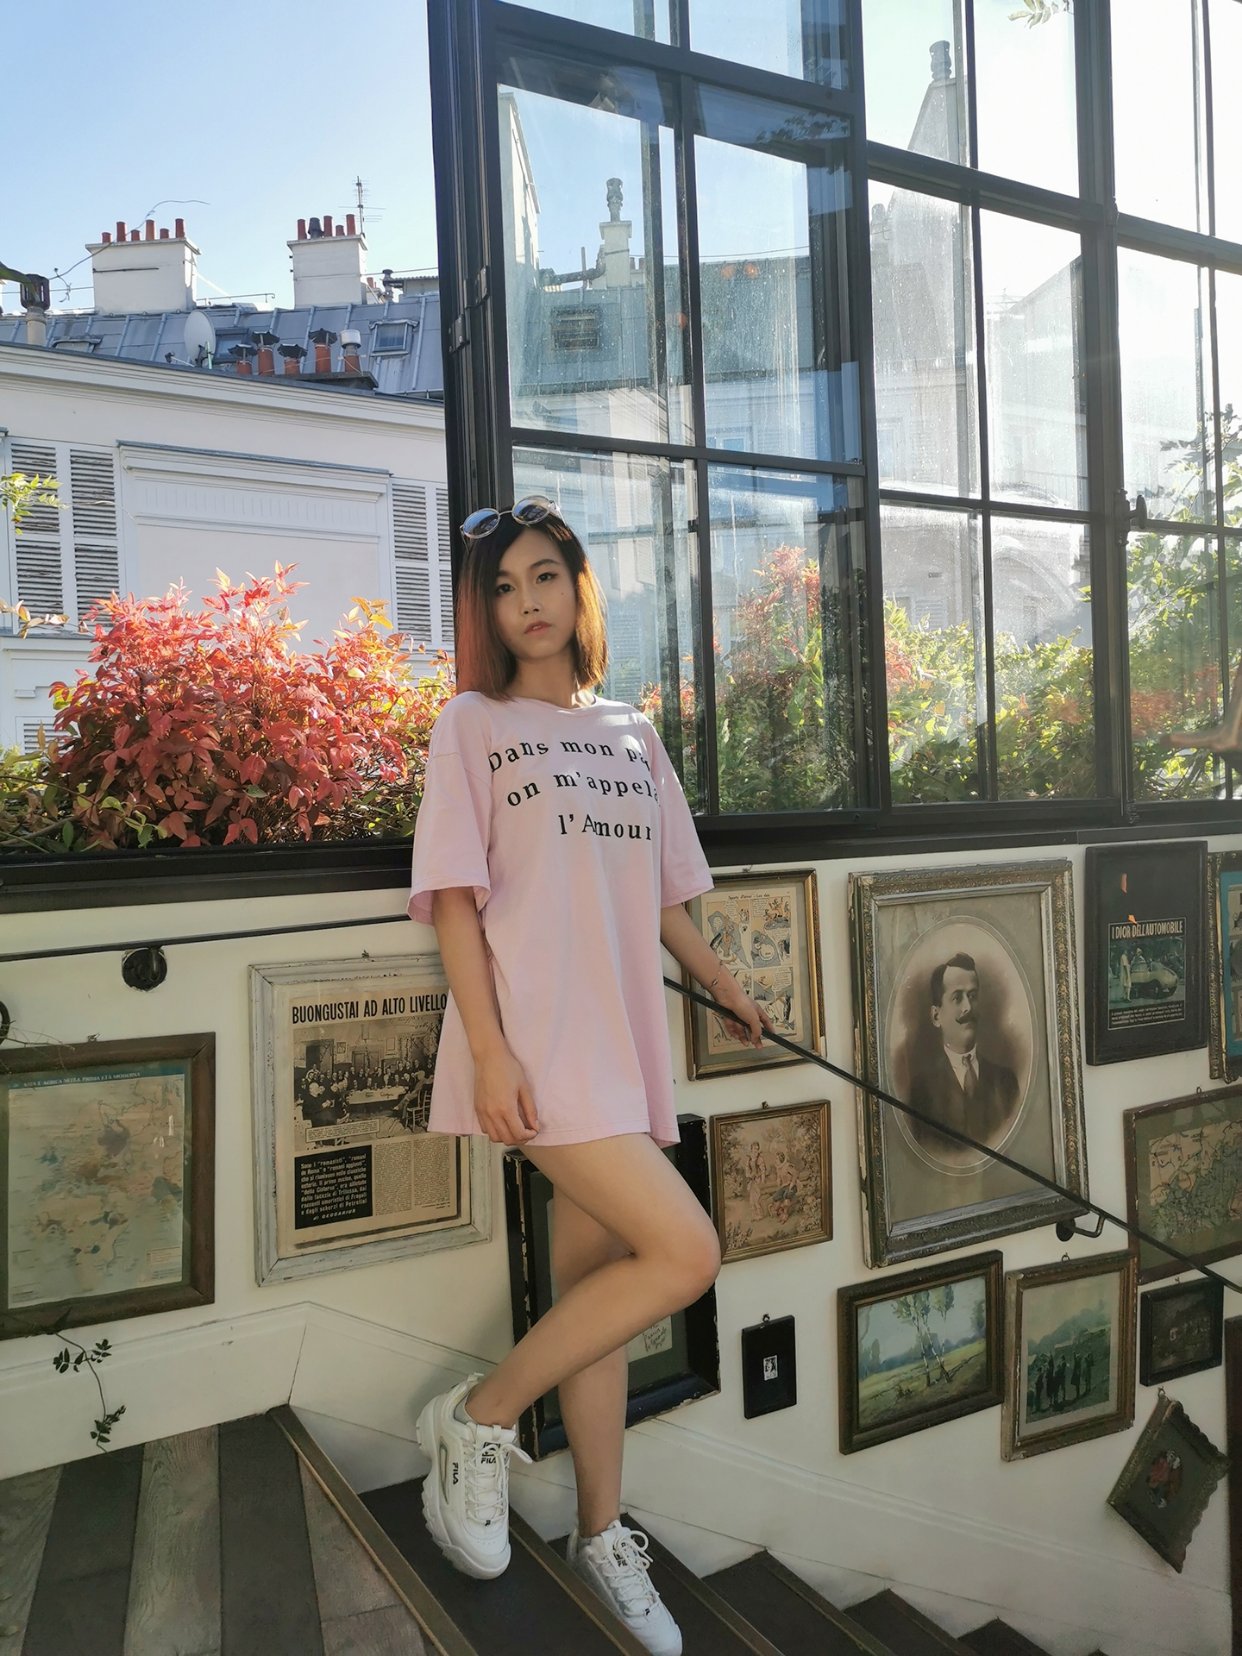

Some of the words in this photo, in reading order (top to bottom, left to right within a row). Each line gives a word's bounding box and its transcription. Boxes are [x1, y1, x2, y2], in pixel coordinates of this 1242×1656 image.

[488, 741, 549, 773] Dans
[560, 740, 614, 757] mon
[507, 781, 541, 807] on
[1115, 925, 1131, 939] DIOR
[292, 1001, 359, 1024] BUONGUSTAI
[364, 1000, 378, 1017] AD
[382, 997, 405, 1015] ALTO
[410, 993, 448, 1013] LIVELLO
